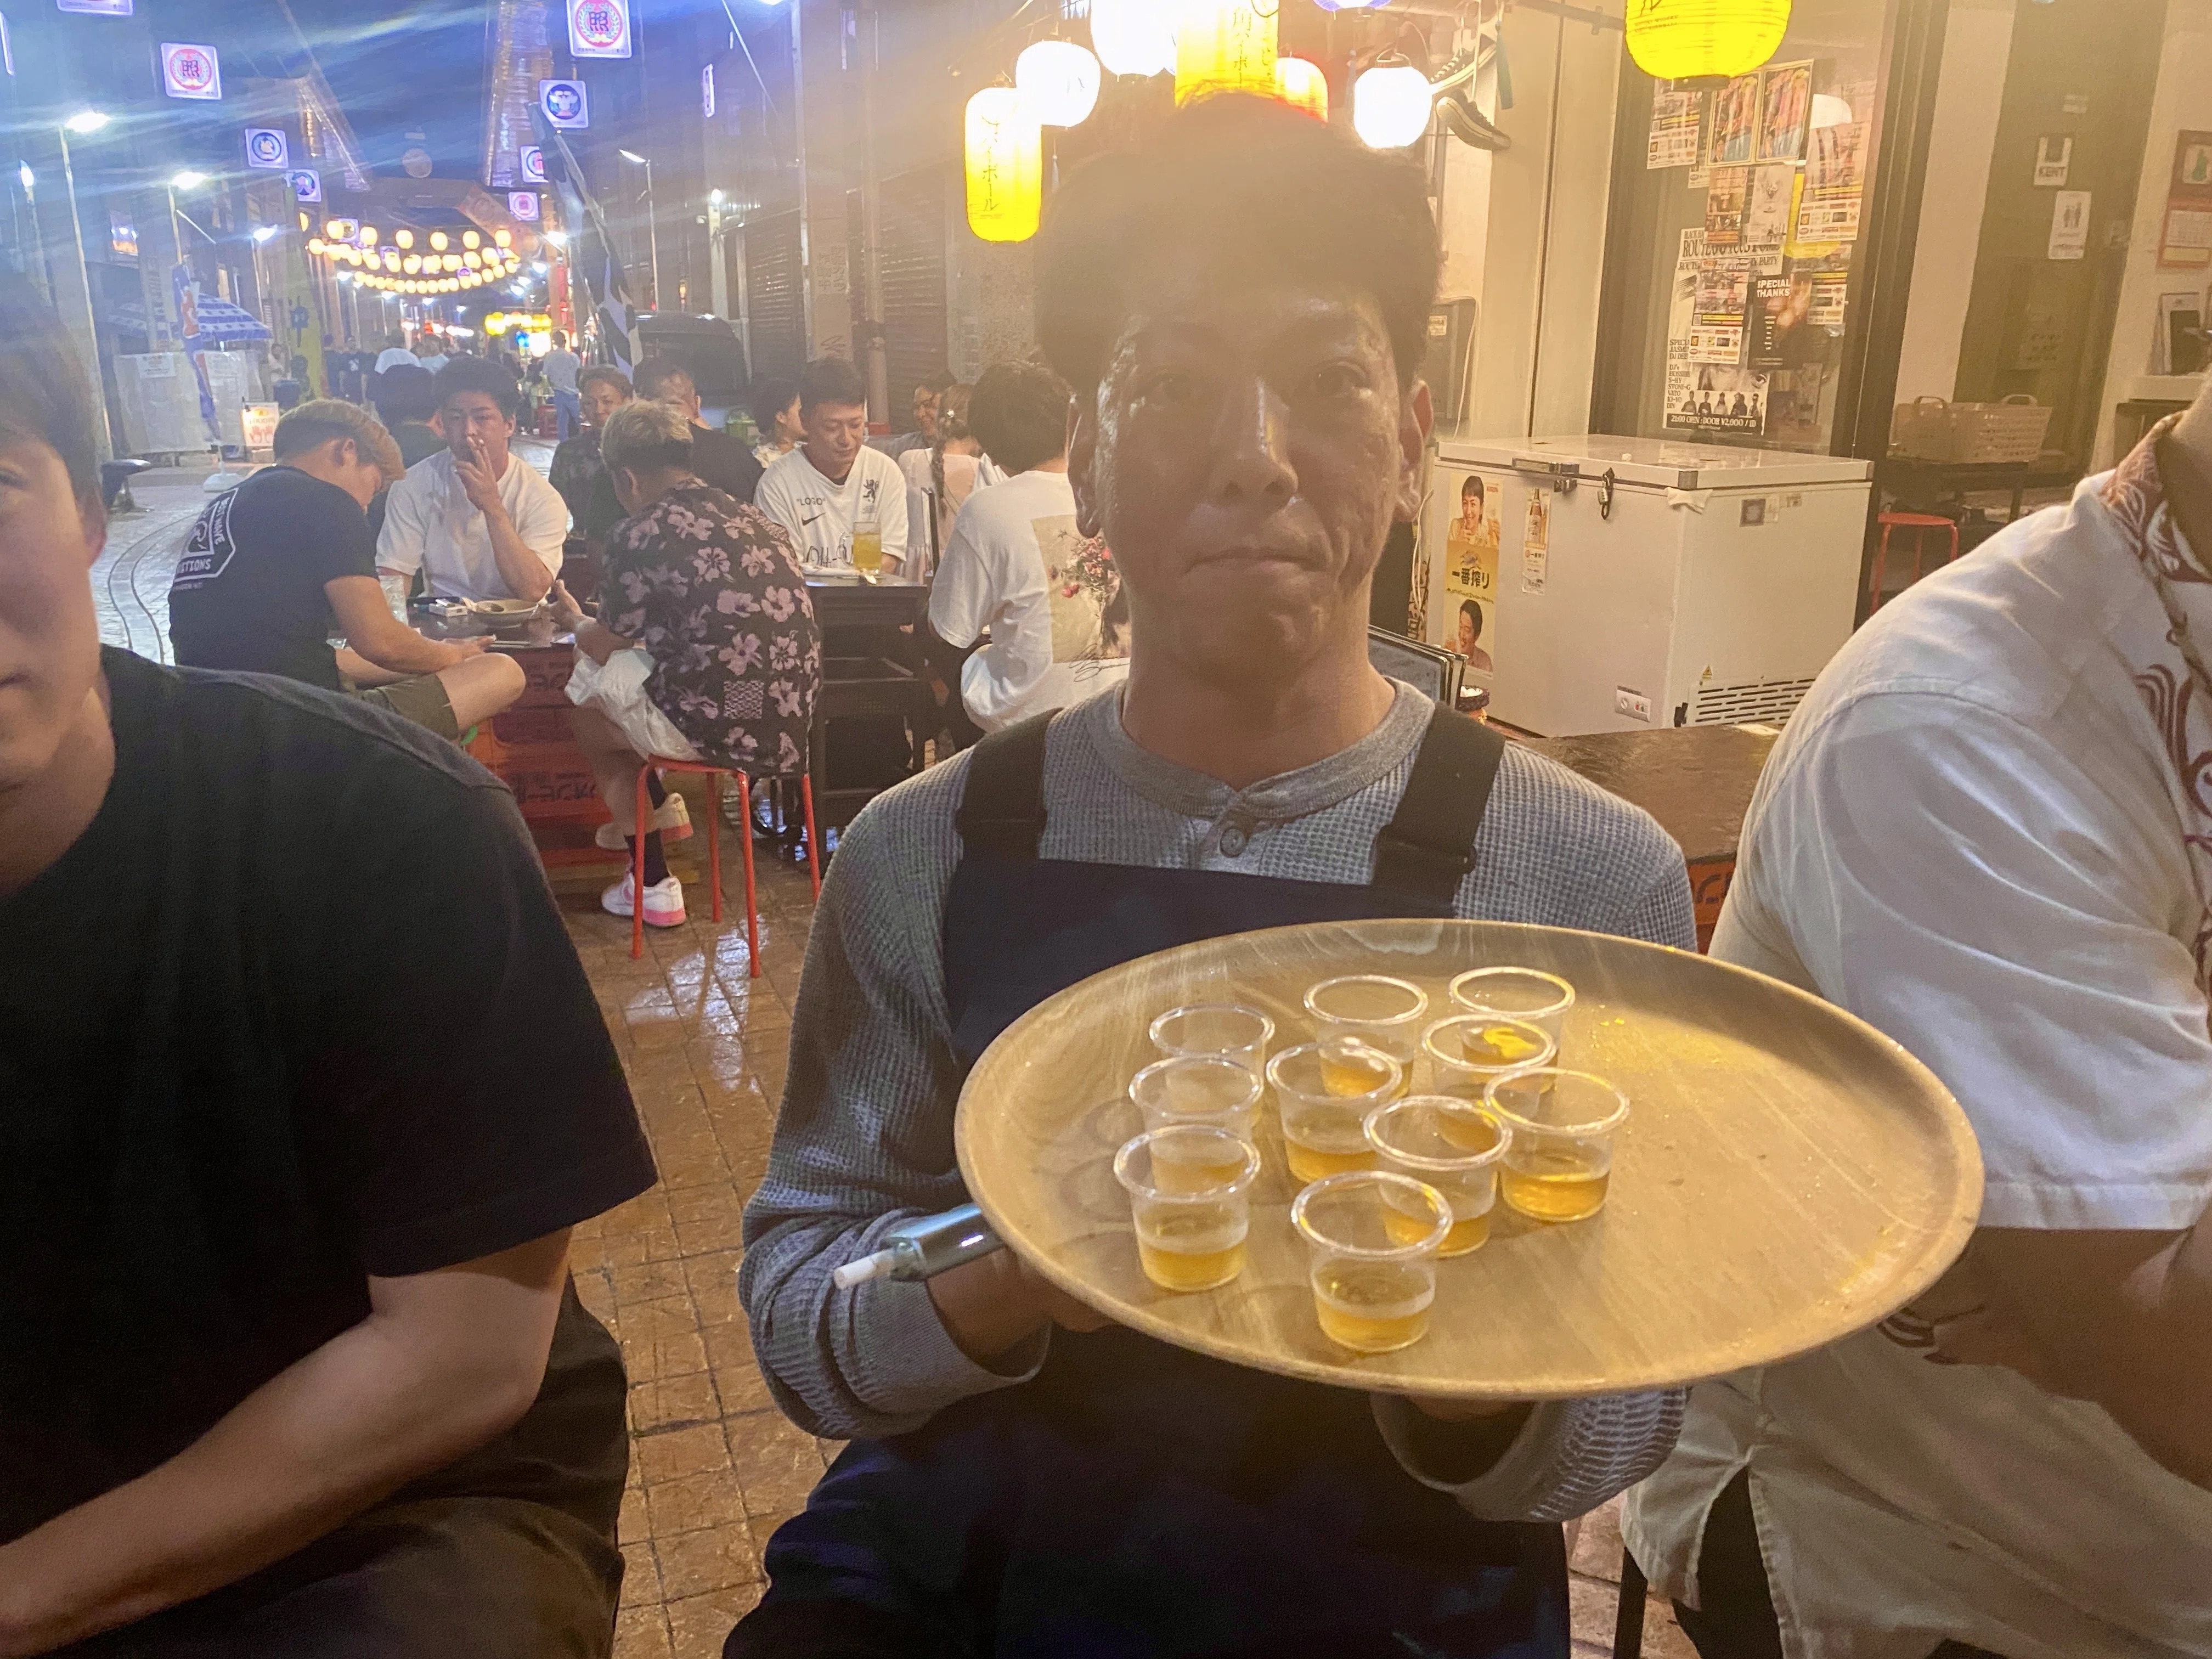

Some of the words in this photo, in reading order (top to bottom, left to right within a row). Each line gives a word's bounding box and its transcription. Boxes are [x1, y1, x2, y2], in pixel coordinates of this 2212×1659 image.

[1757, 279, 1791, 289] SPECIAL
[1757, 288, 1791, 298] THANKS
[1452, 567, 1490, 589] 一番搾り
